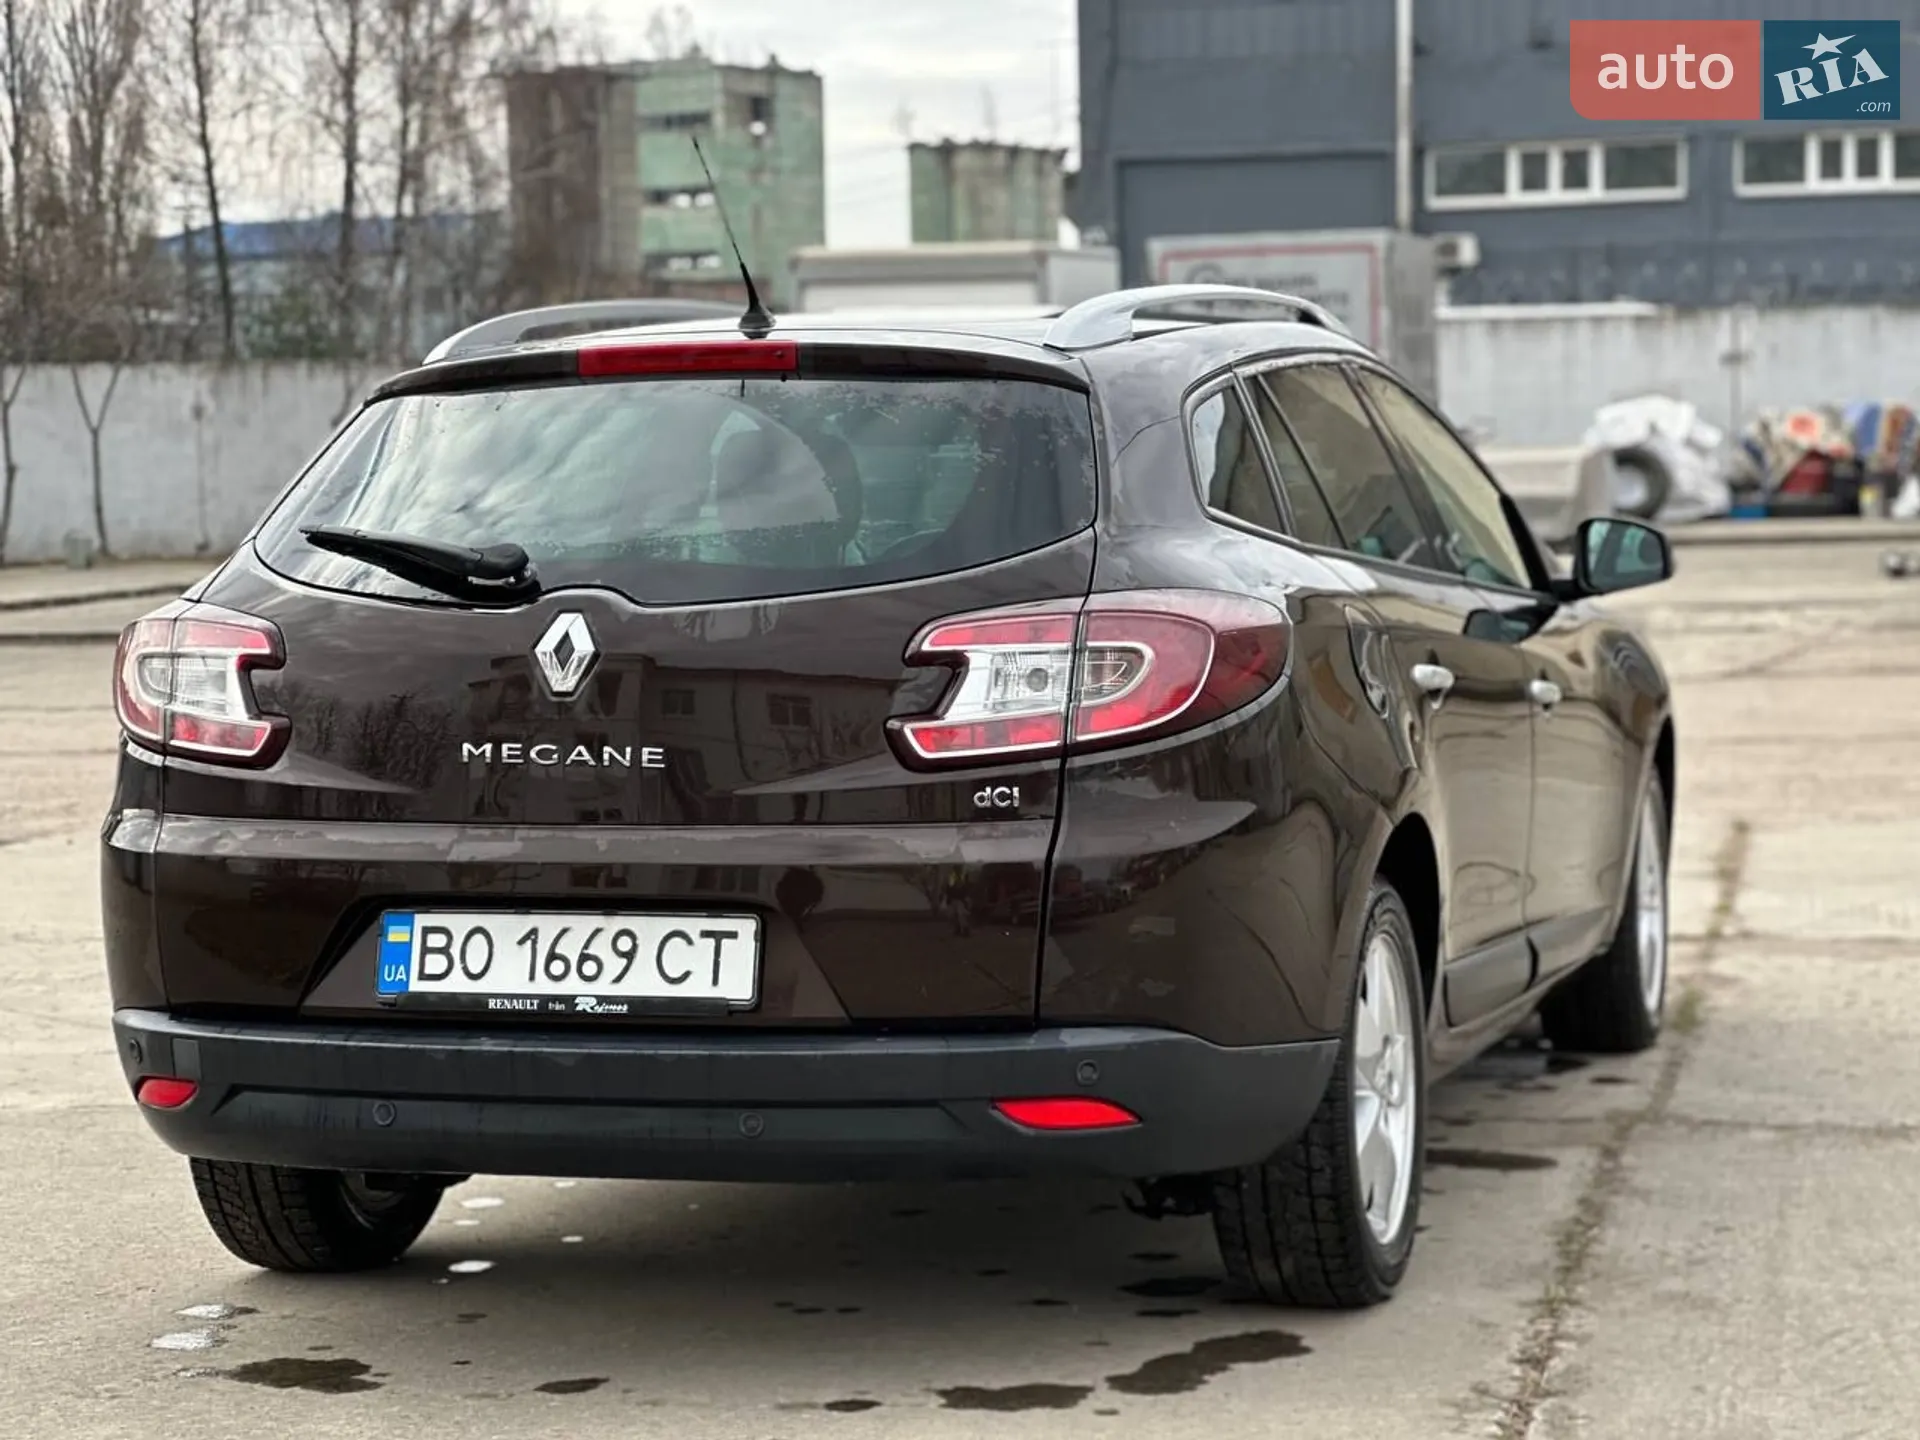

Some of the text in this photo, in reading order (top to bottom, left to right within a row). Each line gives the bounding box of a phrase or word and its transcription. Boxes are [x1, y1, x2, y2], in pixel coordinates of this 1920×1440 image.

[461, 742, 666, 768] MEGANE
[417, 925, 739, 988] BO 1669 CT
[383, 964, 407, 982] UA
[488, 998, 540, 1011] RENAULT
